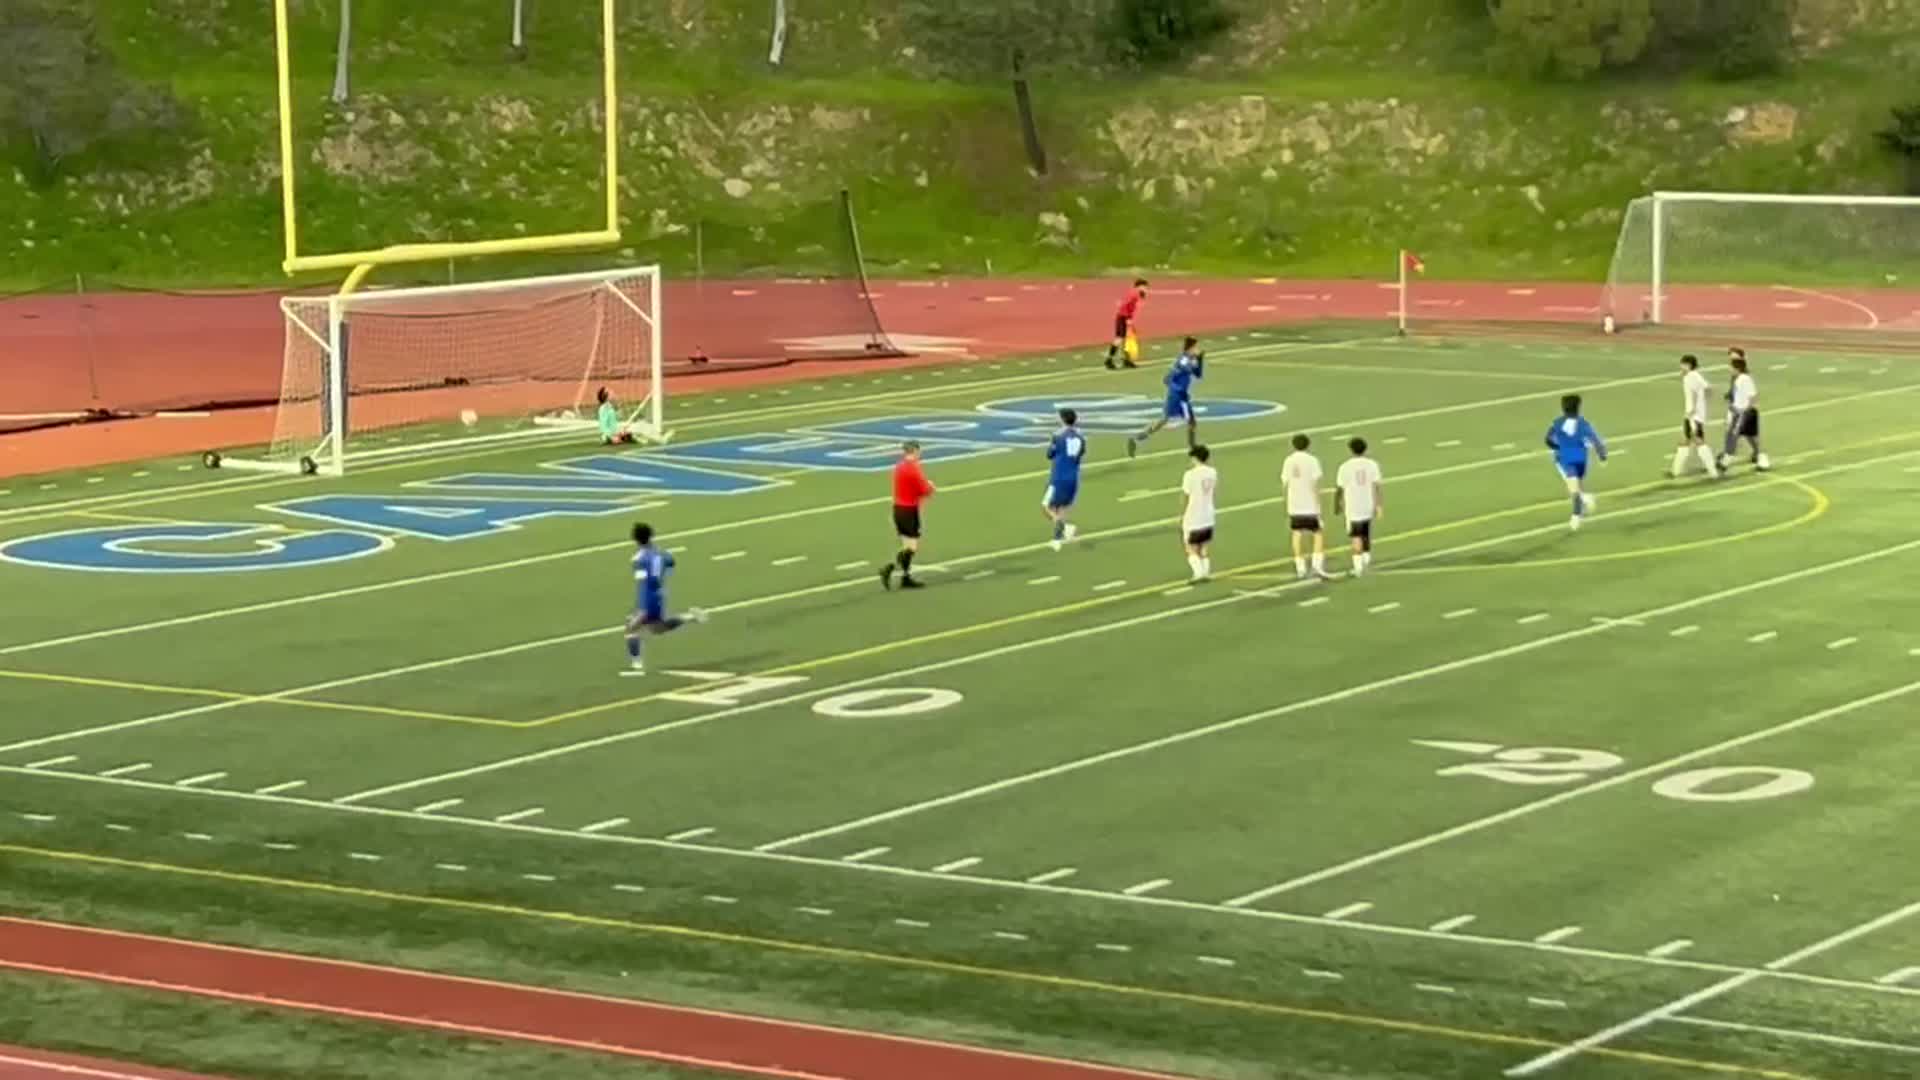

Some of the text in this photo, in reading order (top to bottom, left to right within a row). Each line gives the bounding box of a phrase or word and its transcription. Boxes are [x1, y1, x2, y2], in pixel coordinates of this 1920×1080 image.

[0, 393, 1287, 573] CAVERS
[657, 674, 963, 717] 10
[1434, 746, 1815, 802] 20
